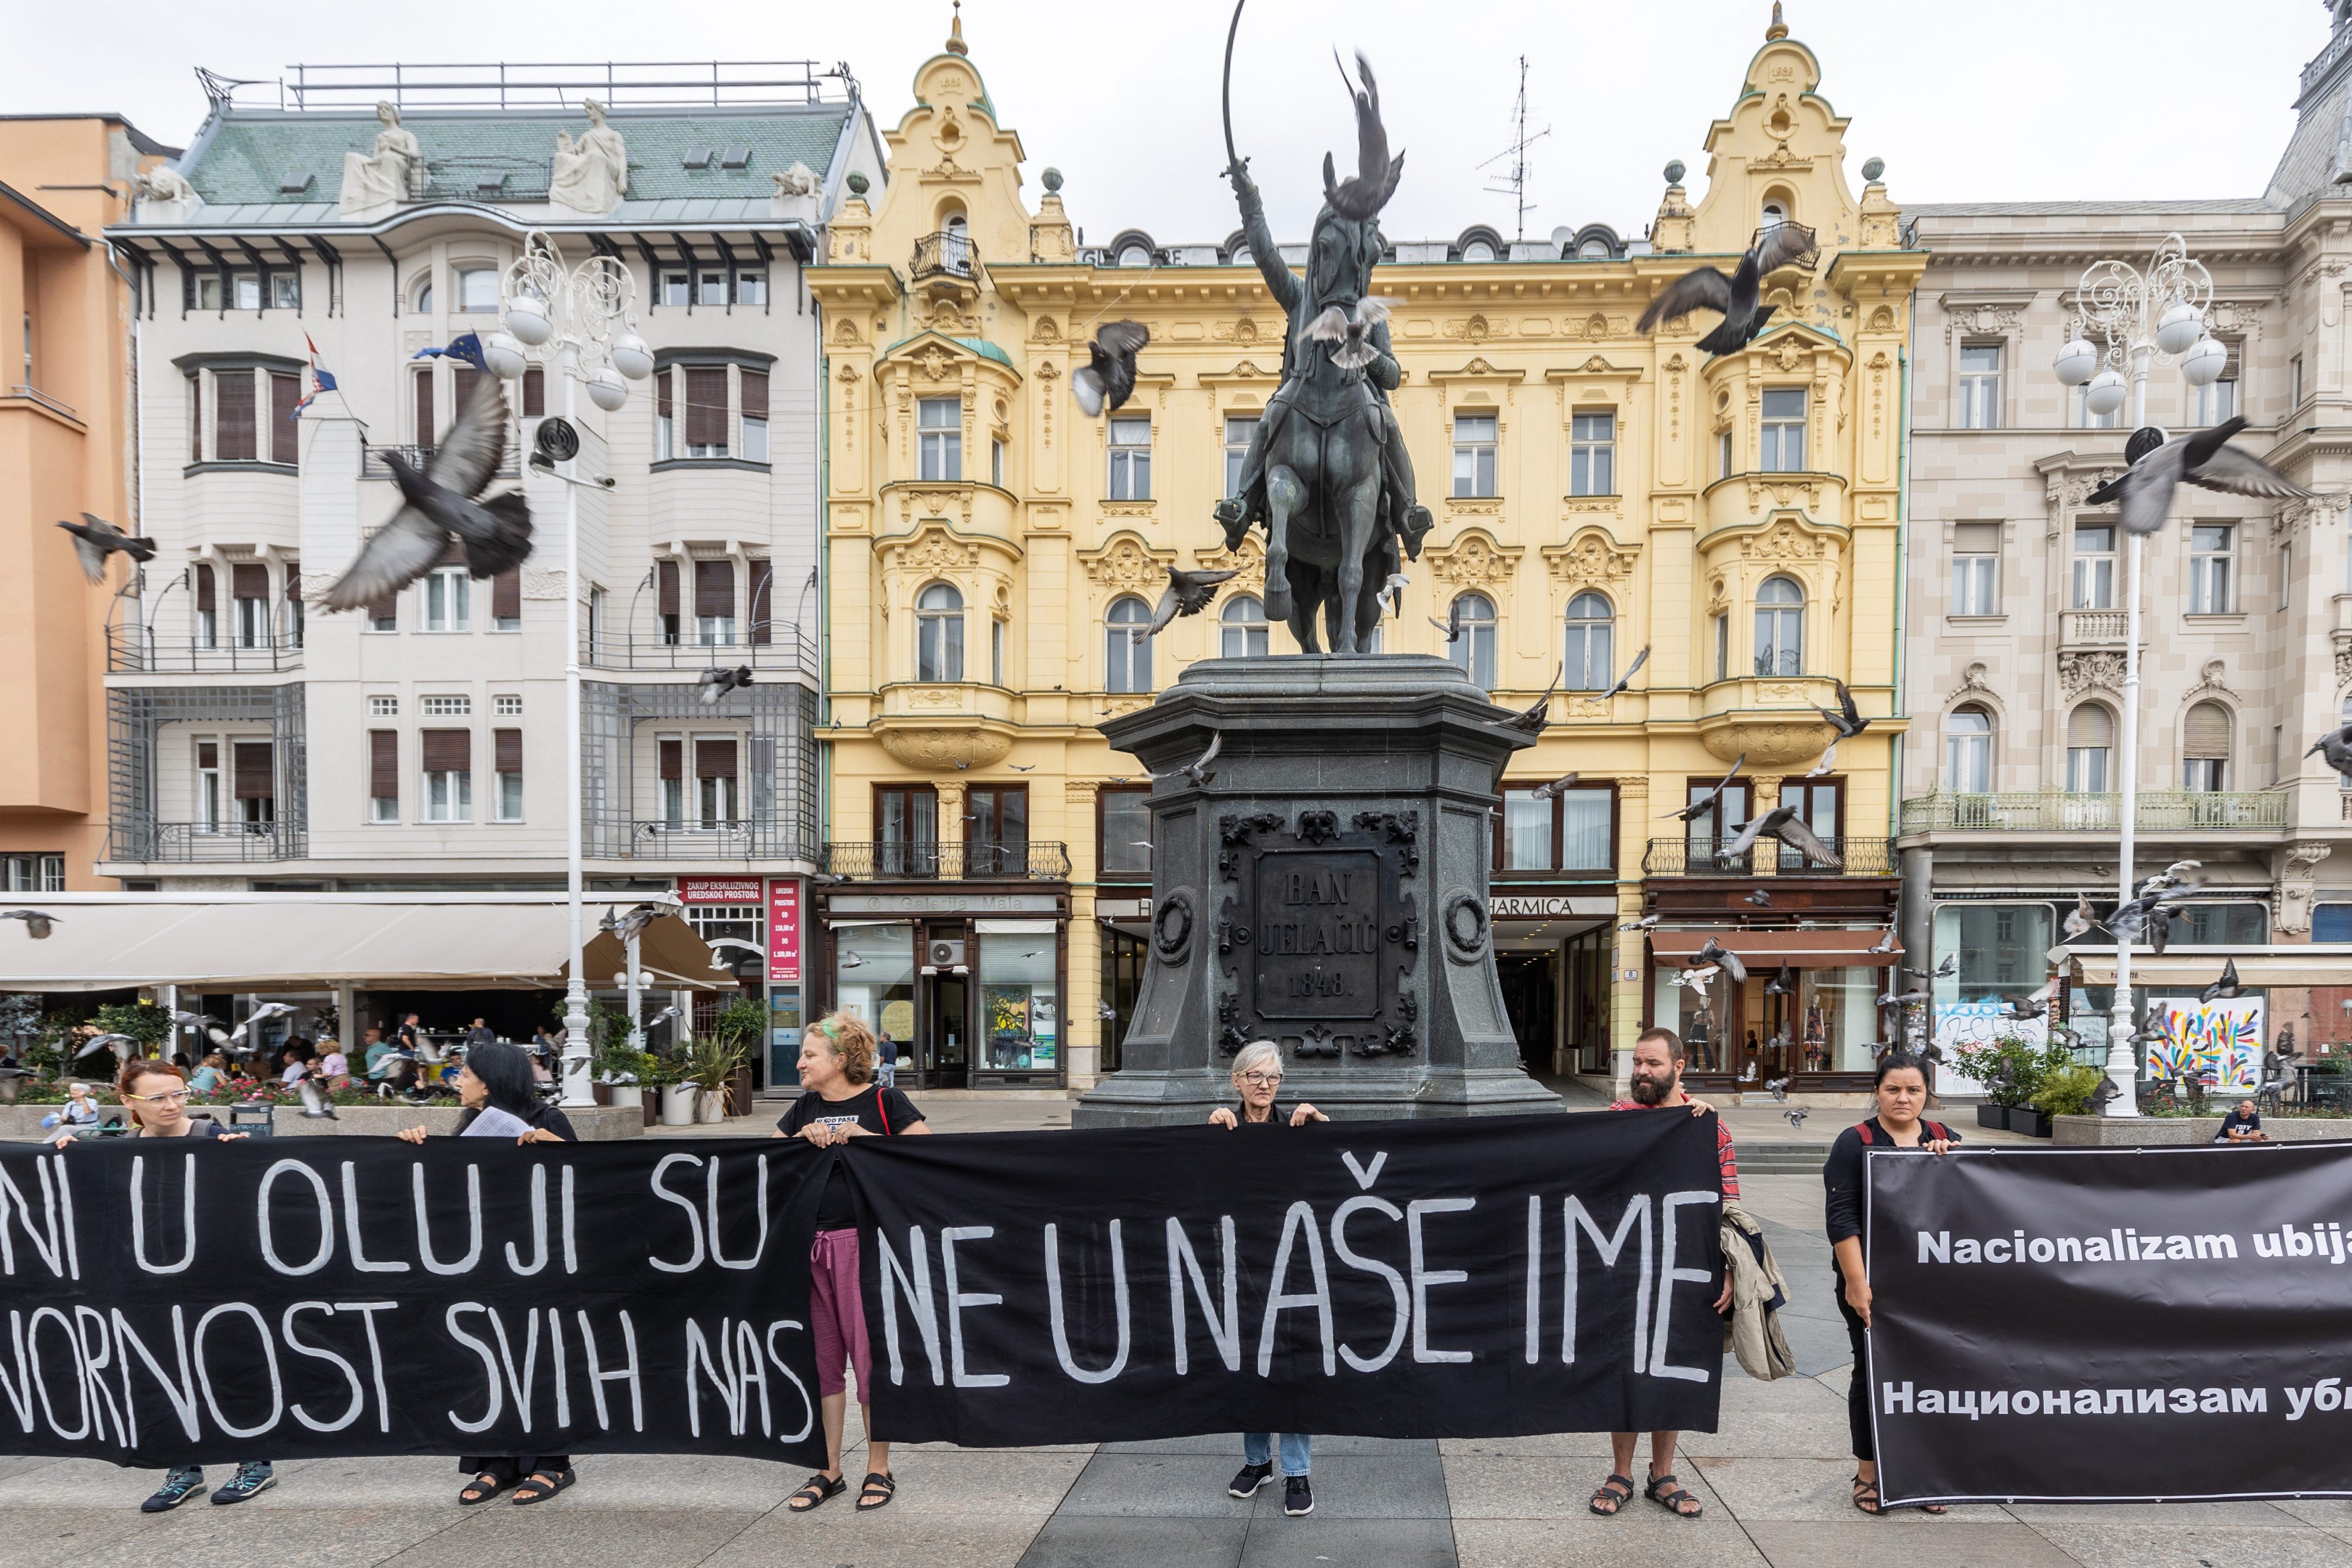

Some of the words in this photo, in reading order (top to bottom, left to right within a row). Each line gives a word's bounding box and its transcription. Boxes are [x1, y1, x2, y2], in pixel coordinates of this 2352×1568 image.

[687, 882, 709, 890] ZAKUP
[710, 882, 759, 890] EKSKLUZIVNOG
[687, 891, 723, 899] UREDSKOG
[724, 891, 759, 899] PROSTORA
[901, 897, 968, 910] Galerija
[983, 896, 1023, 910] Mala
[1285, 874, 1352, 905] BAN
[1260, 913, 1377, 955] JELAČIĆ
[131, 1153, 196, 1274] U
[258, 1158, 577, 1276] OLUJI
[649, 1153, 768, 1273] SU
[1917, 1228, 2238, 1263] Nacionalizam
[878, 1225, 1010, 1388] NE
[1045, 1219, 1130, 1383] U
[1167, 1151, 1476, 1378] NAŠE
[1525, 1191, 1719, 1383] IME
[446, 1302, 643, 1433] SVIH
[687, 1317, 813, 1443] NAS
[1883, 1382, 2267, 1420] Национализам
[2284, 1378, 2352, 1420] уб
